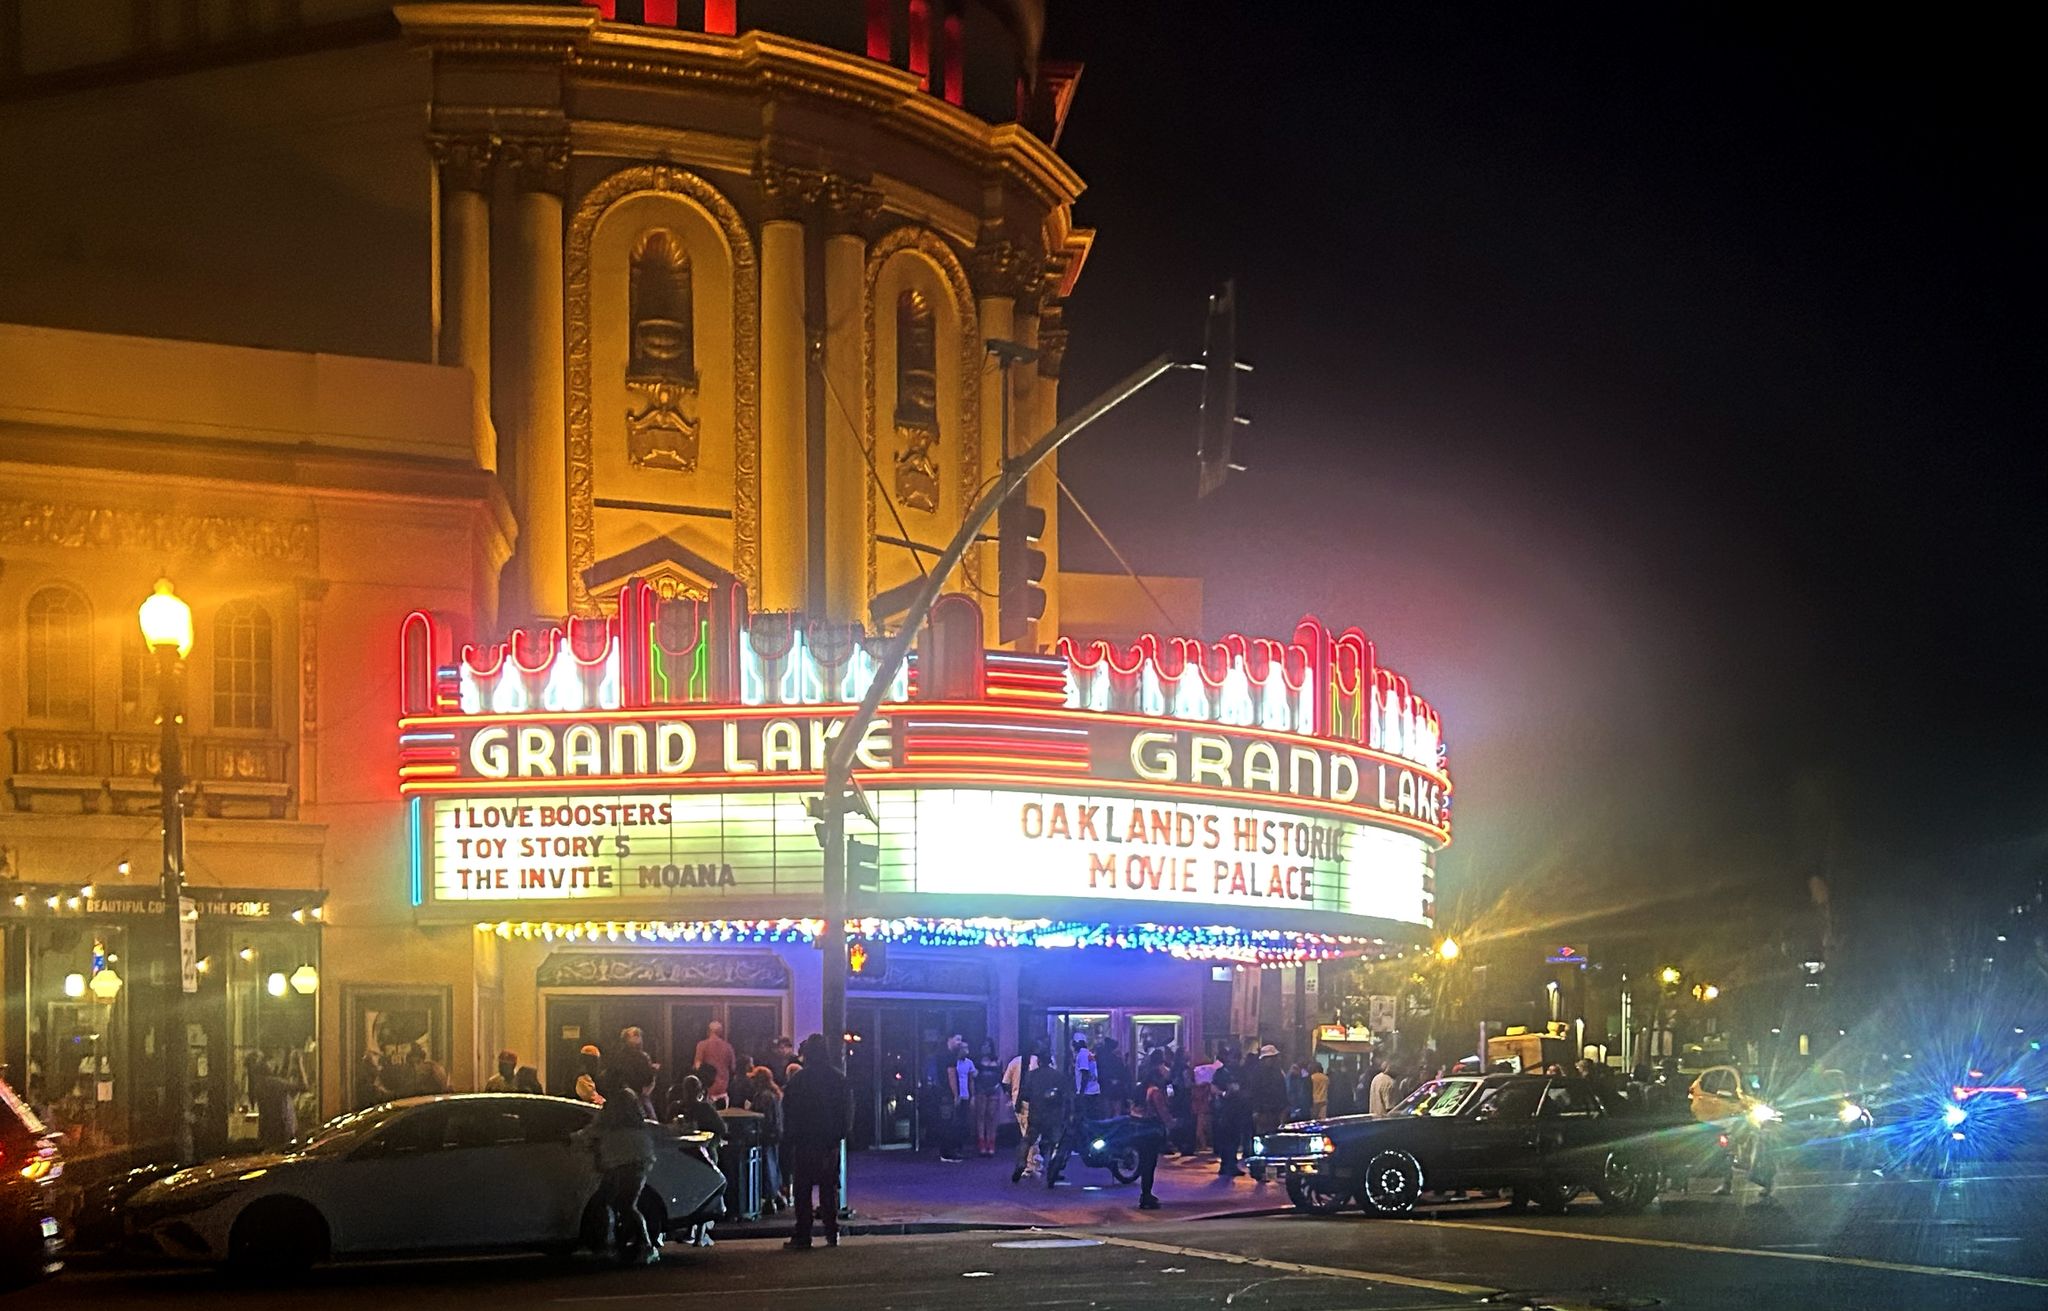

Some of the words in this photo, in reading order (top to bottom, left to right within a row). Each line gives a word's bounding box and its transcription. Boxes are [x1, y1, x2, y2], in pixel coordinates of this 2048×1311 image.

[469, 718, 697, 779] GRAND
[722, 716, 893, 775] LAKE
[1129, 729, 1360, 804] GRAND
[1378, 763, 1441, 825] LAKE
[454, 807, 461, 829] I
[469, 805, 533, 828] LOVE
[540, 802, 672, 827] BOOSTERS
[1021, 802, 1221, 850] OAKLAND'S
[1233, 815, 1345, 863] HISTORIC
[457, 838, 507, 859] TOY
[520, 835, 604, 858] STORY
[615, 835, 630, 858] 5
[457, 868, 509, 890] THE
[520, 865, 613, 889] INVITE
[638, 863, 737, 889] MOANA
[1088, 852, 1198, 893] MOVIE
[1212, 859, 1314, 902] PALACE
[86, 899, 146, 914] BEAUTIFUL
[207, 902, 228, 915] THE
